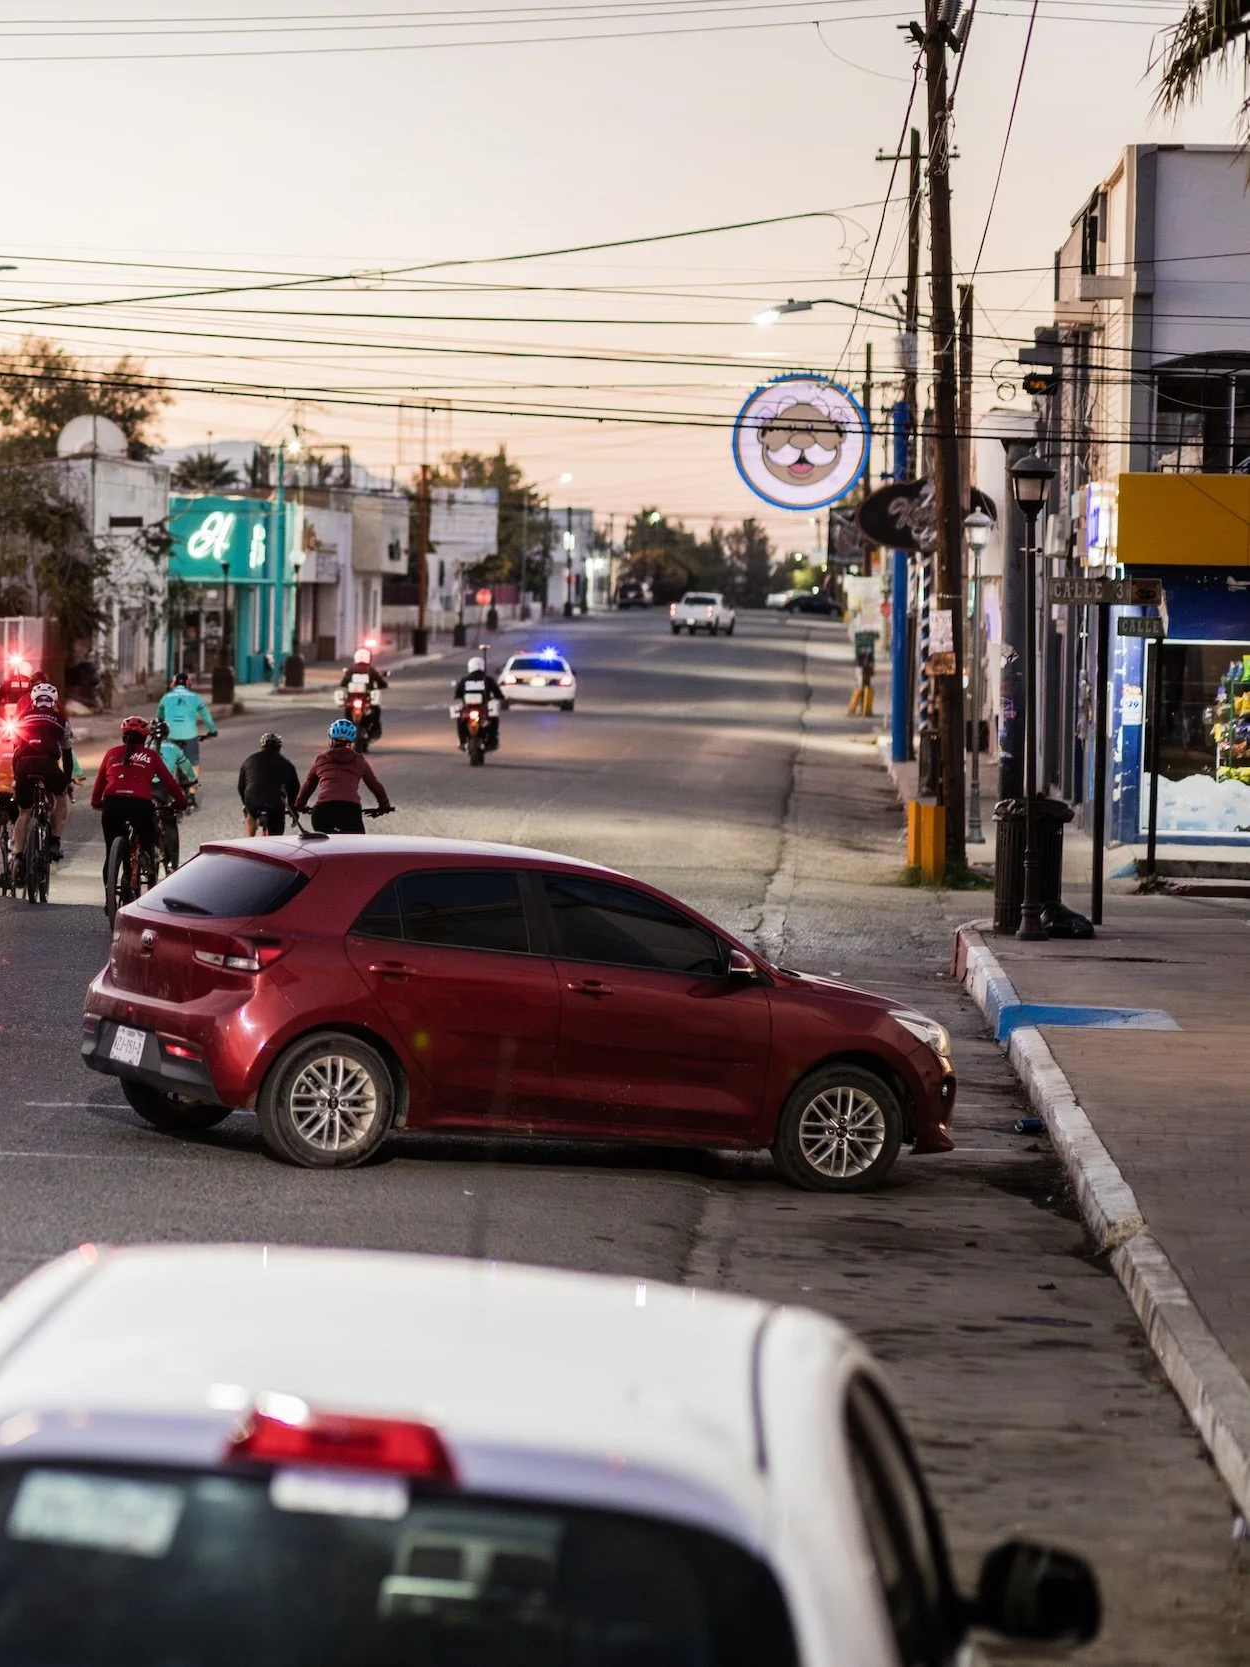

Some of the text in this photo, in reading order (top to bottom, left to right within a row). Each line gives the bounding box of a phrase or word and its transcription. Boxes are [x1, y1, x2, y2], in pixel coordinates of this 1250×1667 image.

[1053, 582, 1125, 599] CALLE 3
[1122, 620, 1159, 633] CALLE
